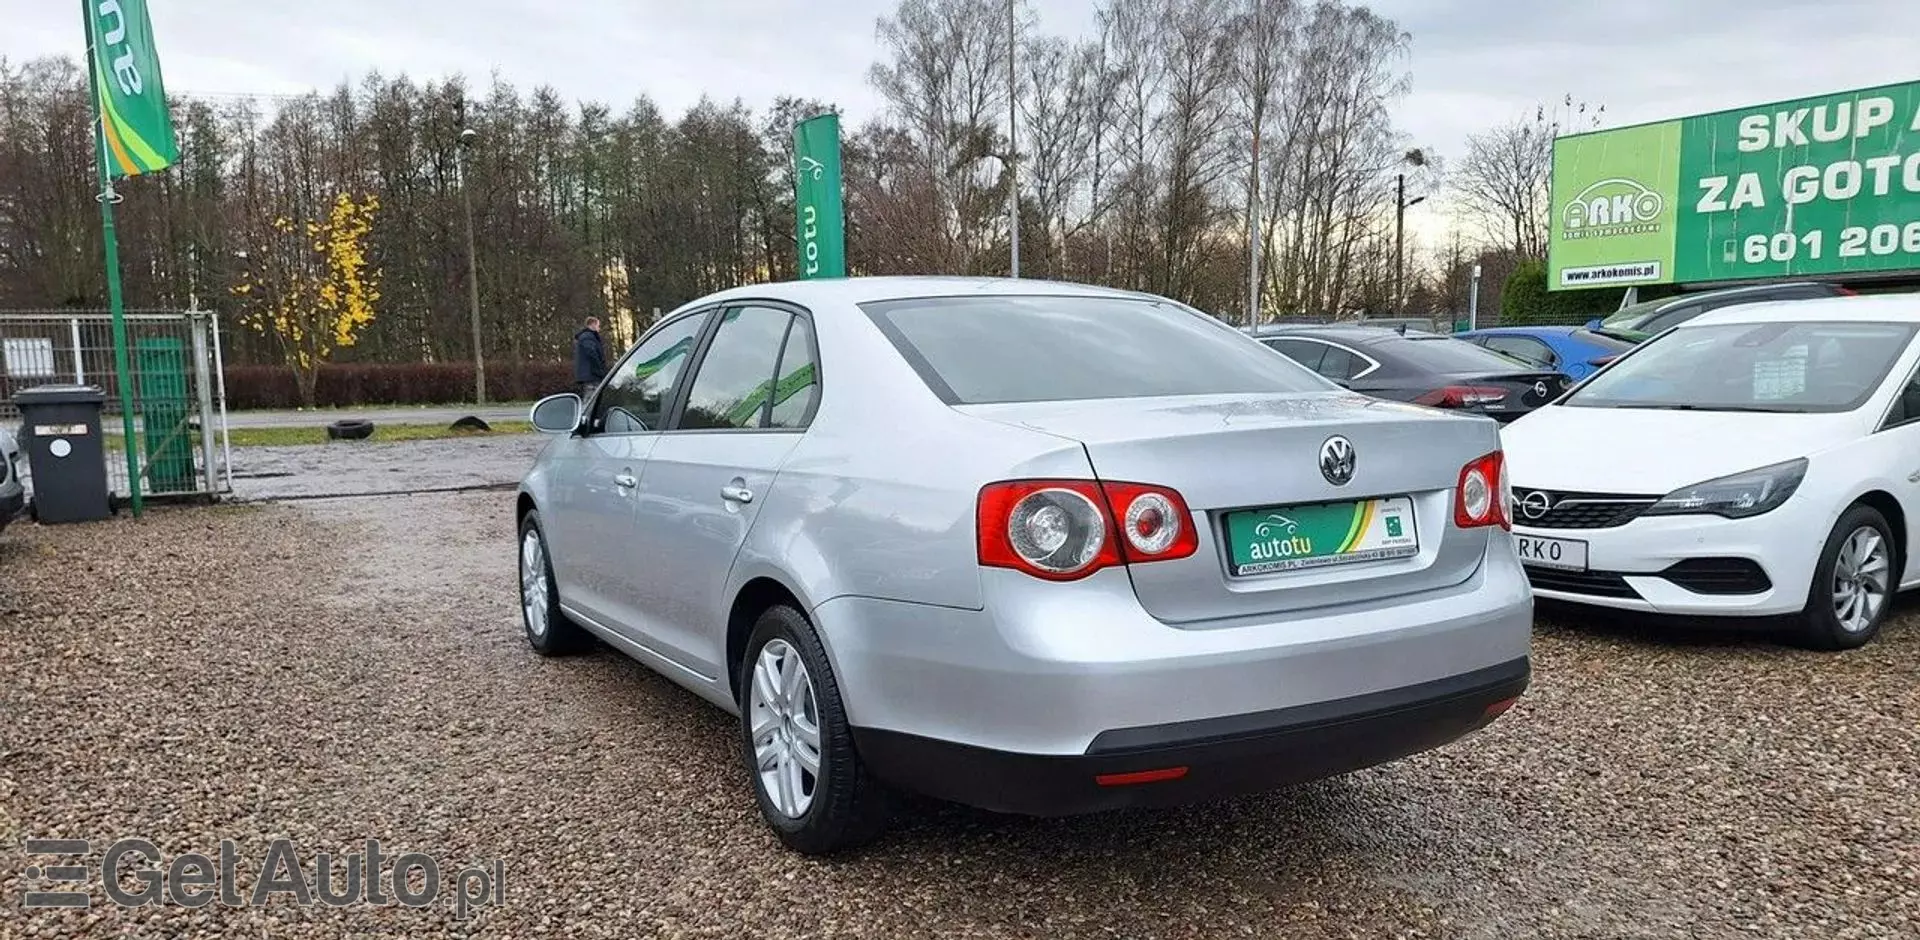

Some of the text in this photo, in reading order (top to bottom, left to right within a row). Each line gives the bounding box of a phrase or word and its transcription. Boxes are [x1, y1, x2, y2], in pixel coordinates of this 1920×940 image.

[1738, 97, 1895, 152] SKUP
[1563, 191, 1662, 229] ARKO
[1697, 172, 1765, 213] ZA
[804, 206, 819, 276] totu
[1744, 230, 1822, 263] 601
[1567, 265, 1655, 281] www.arkokomis.pl
[1251, 536, 1312, 559] autotu
[1519, 539, 1561, 560] RKO
